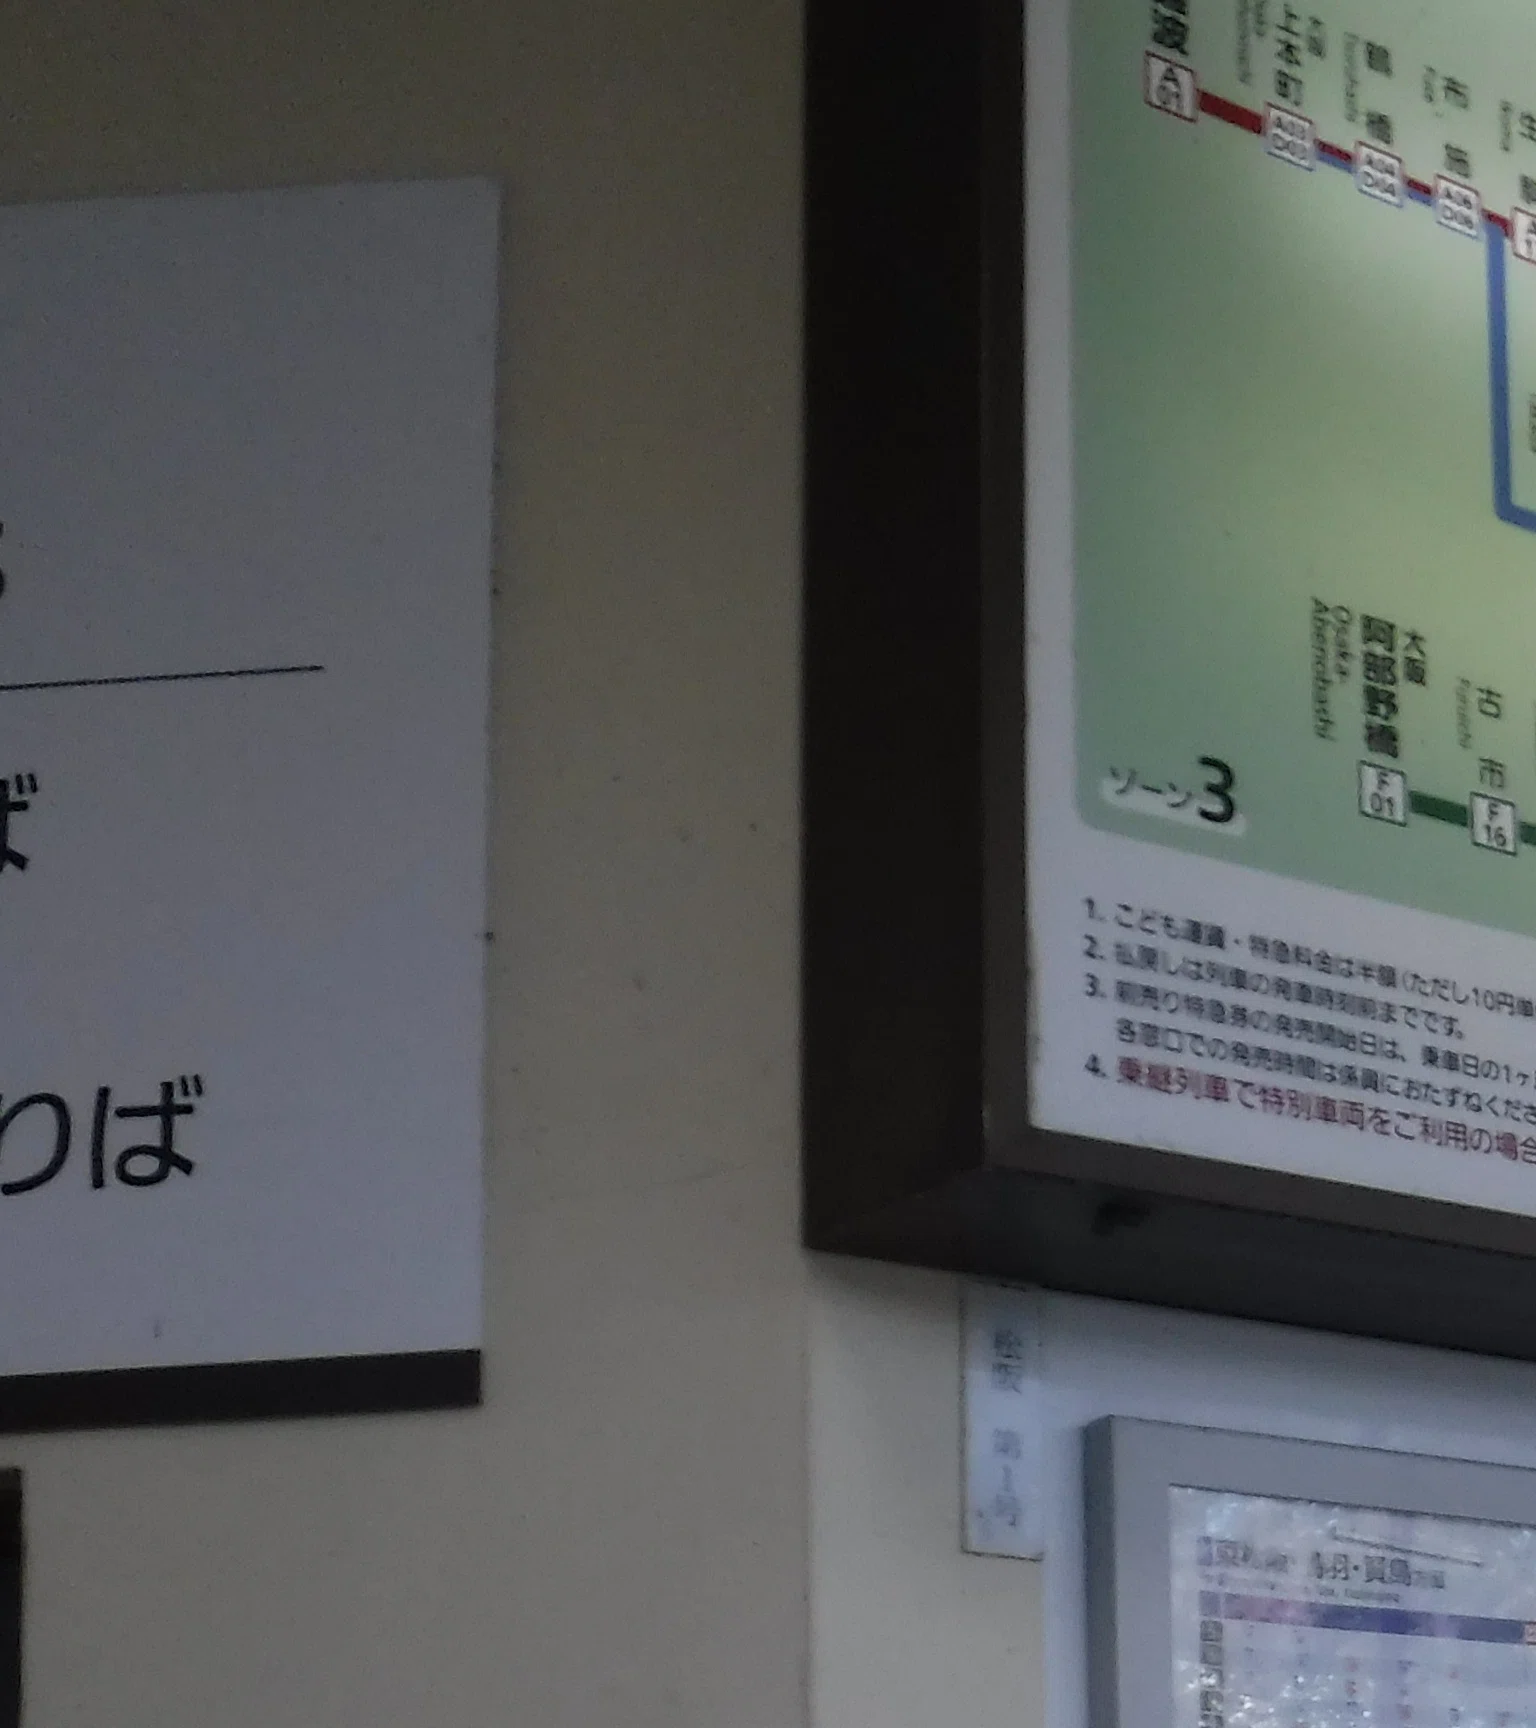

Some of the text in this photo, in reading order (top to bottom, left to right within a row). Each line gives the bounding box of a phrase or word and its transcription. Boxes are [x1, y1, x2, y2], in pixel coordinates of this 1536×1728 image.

[1109, 755, 1234, 823] ゾーン3
[1485, 822, 1507, 848] 16
